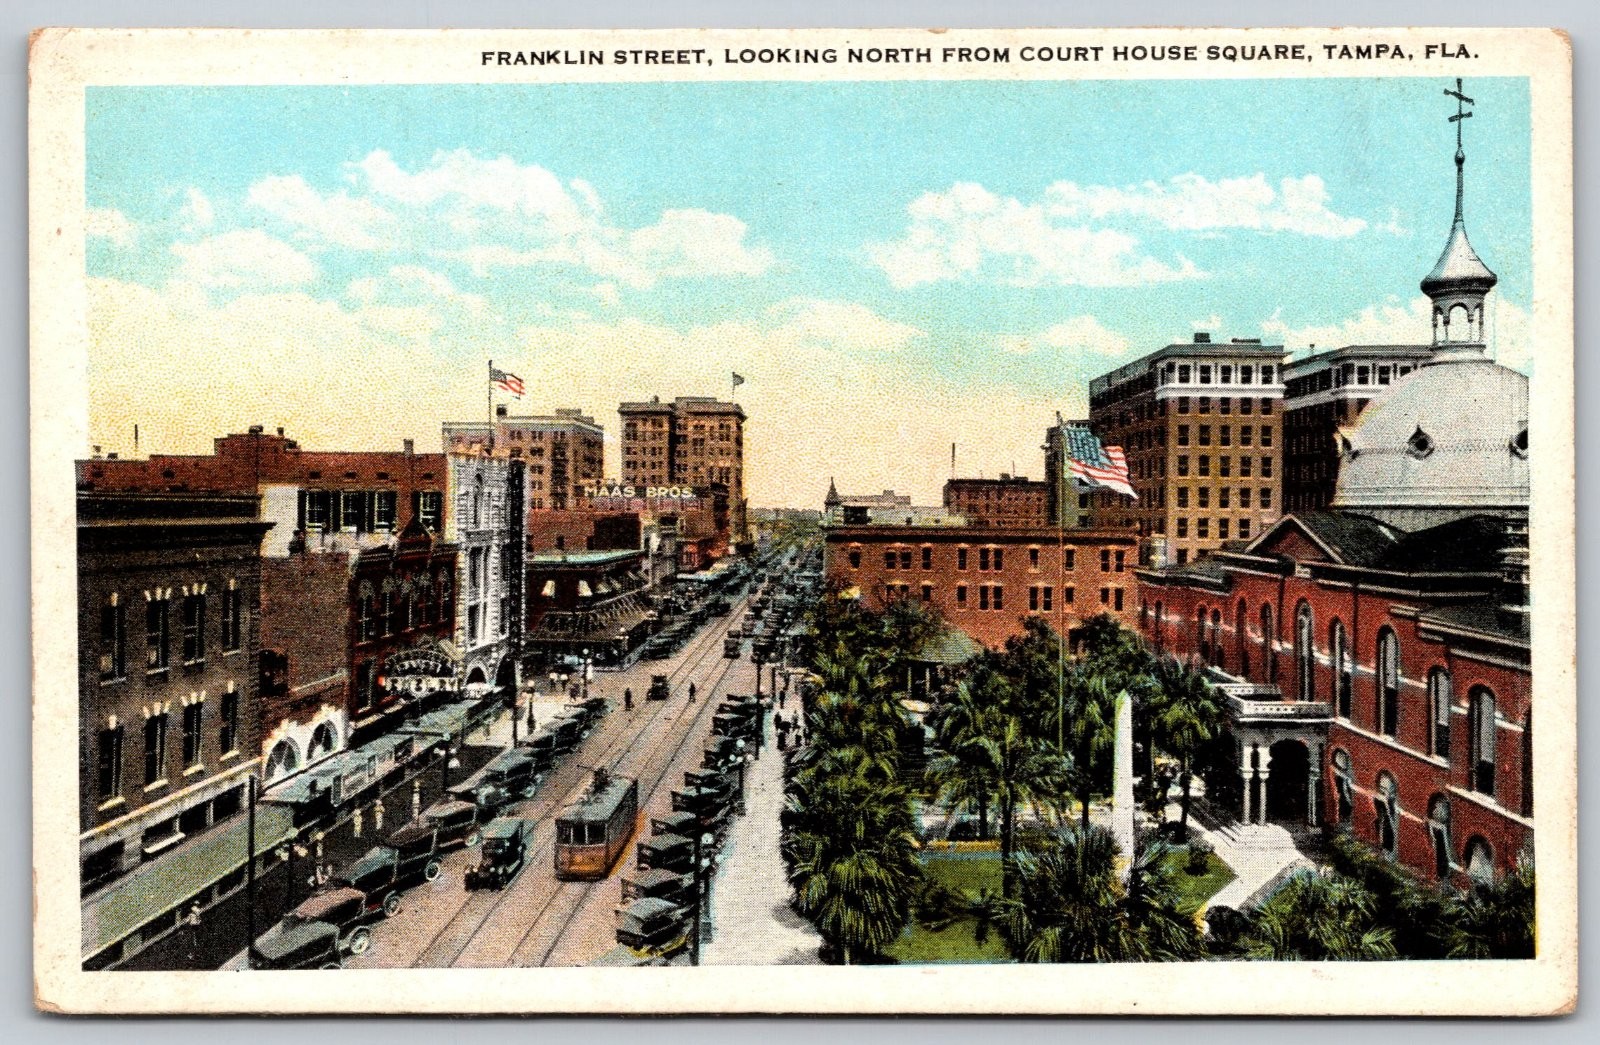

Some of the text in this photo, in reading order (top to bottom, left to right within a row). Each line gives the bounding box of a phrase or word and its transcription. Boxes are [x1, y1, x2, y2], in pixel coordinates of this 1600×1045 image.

[482, 43, 1479, 66] FRANKLIN STREET, LOOKING NORTH FROM COURT HOUSE SQUARE, TAMPA, FLA.
[584, 486, 636, 498] MAAS
